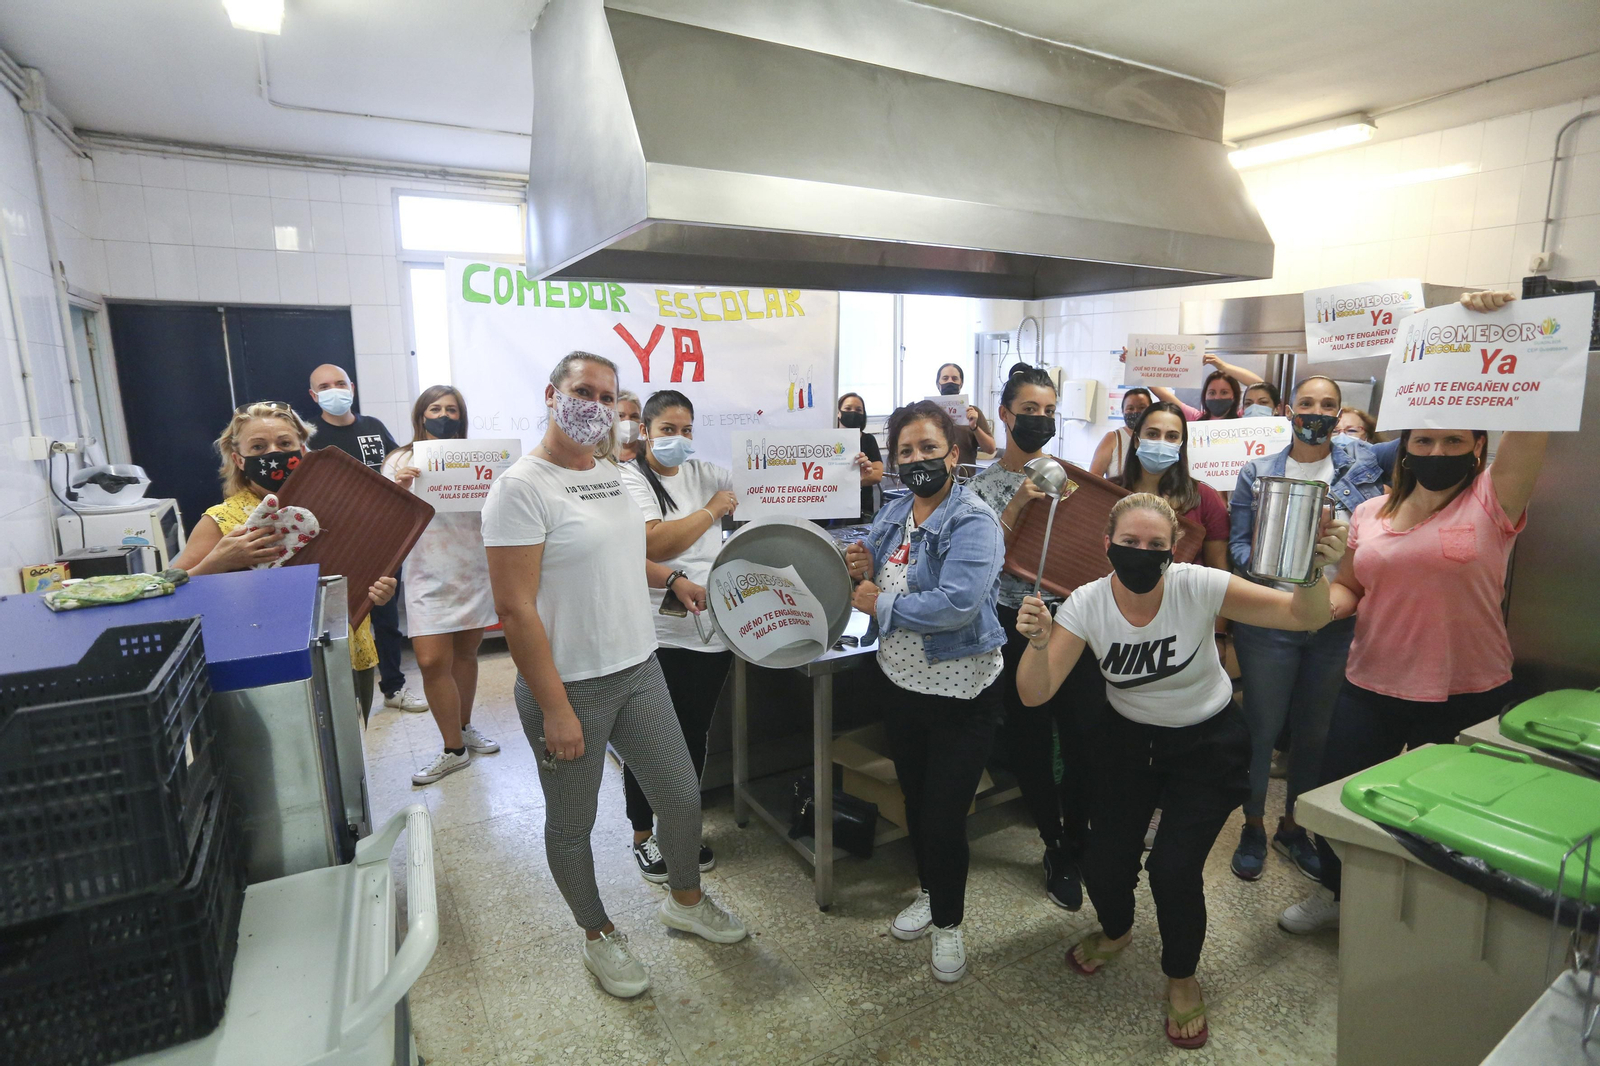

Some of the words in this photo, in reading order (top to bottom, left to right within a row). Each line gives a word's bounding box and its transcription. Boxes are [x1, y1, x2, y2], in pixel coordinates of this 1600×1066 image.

[462, 263, 630, 313] COMEDOR
[655, 288, 805, 321] ESCOLAR
[1336, 293, 1402, 312] COMEDOR
[1370, 309, 1393, 327] Ya
[1356, 329, 1390, 339] ENGAÑEN
[1427, 323, 1537, 345] COMEDOR
[613, 322, 705, 383] YA
[1330, 341, 1354, 351] "AULAS
[1424, 343, 1471, 355] ESCOLAR
[1167, 353, 1181, 365] Ya
[1480, 349, 1518, 375] Ya
[1395, 382, 1415, 398] ¡QUÉ
[1415, 382, 1431, 393] NO
[1434, 382, 1447, 392] TE
[1449, 379, 1509, 392] ENGAÑEN
[1512, 381, 1541, 392] CON
[1407, 396, 1445, 407] "AULAS
[1447, 396, 1462, 406] DE
[1465, 396, 1520, 407] ESPERA"
[511, 417, 530, 431] NO
[702, 414, 715, 427] DE
[1210, 427, 1273, 440] COMEDOR
[767, 445, 833, 459] COMEDOR
[1244, 440, 1266, 456] Ya
[444, 451, 501, 463] COMEDOR
[474, 465, 493, 480] Ya
[802, 461, 824, 481] Ya
[1192, 461, 1208, 470] ¡QUÉ
[1204, 469, 1229, 477] "AULAS
[462, 482, 491, 491] ENGAÑEN
[746, 485, 764, 495] ¡QUÉ
[777, 485, 786, 493] TE
[787, 483, 821, 493] ENGAÑEN
[822, 484, 838, 493] CON
[759, 495, 786, 504] "AULAS
[786, 495, 796, 503] DE
[797, 494, 828, 503] ESPERA"
[773, 589, 797, 607] Ya
[752, 616, 763, 628] NO
[763, 611, 773, 621] TE
[752, 622, 778, 640] "AULAS
[778, 619, 788, 628] DE
[1101, 635, 1177, 675] NIKE
